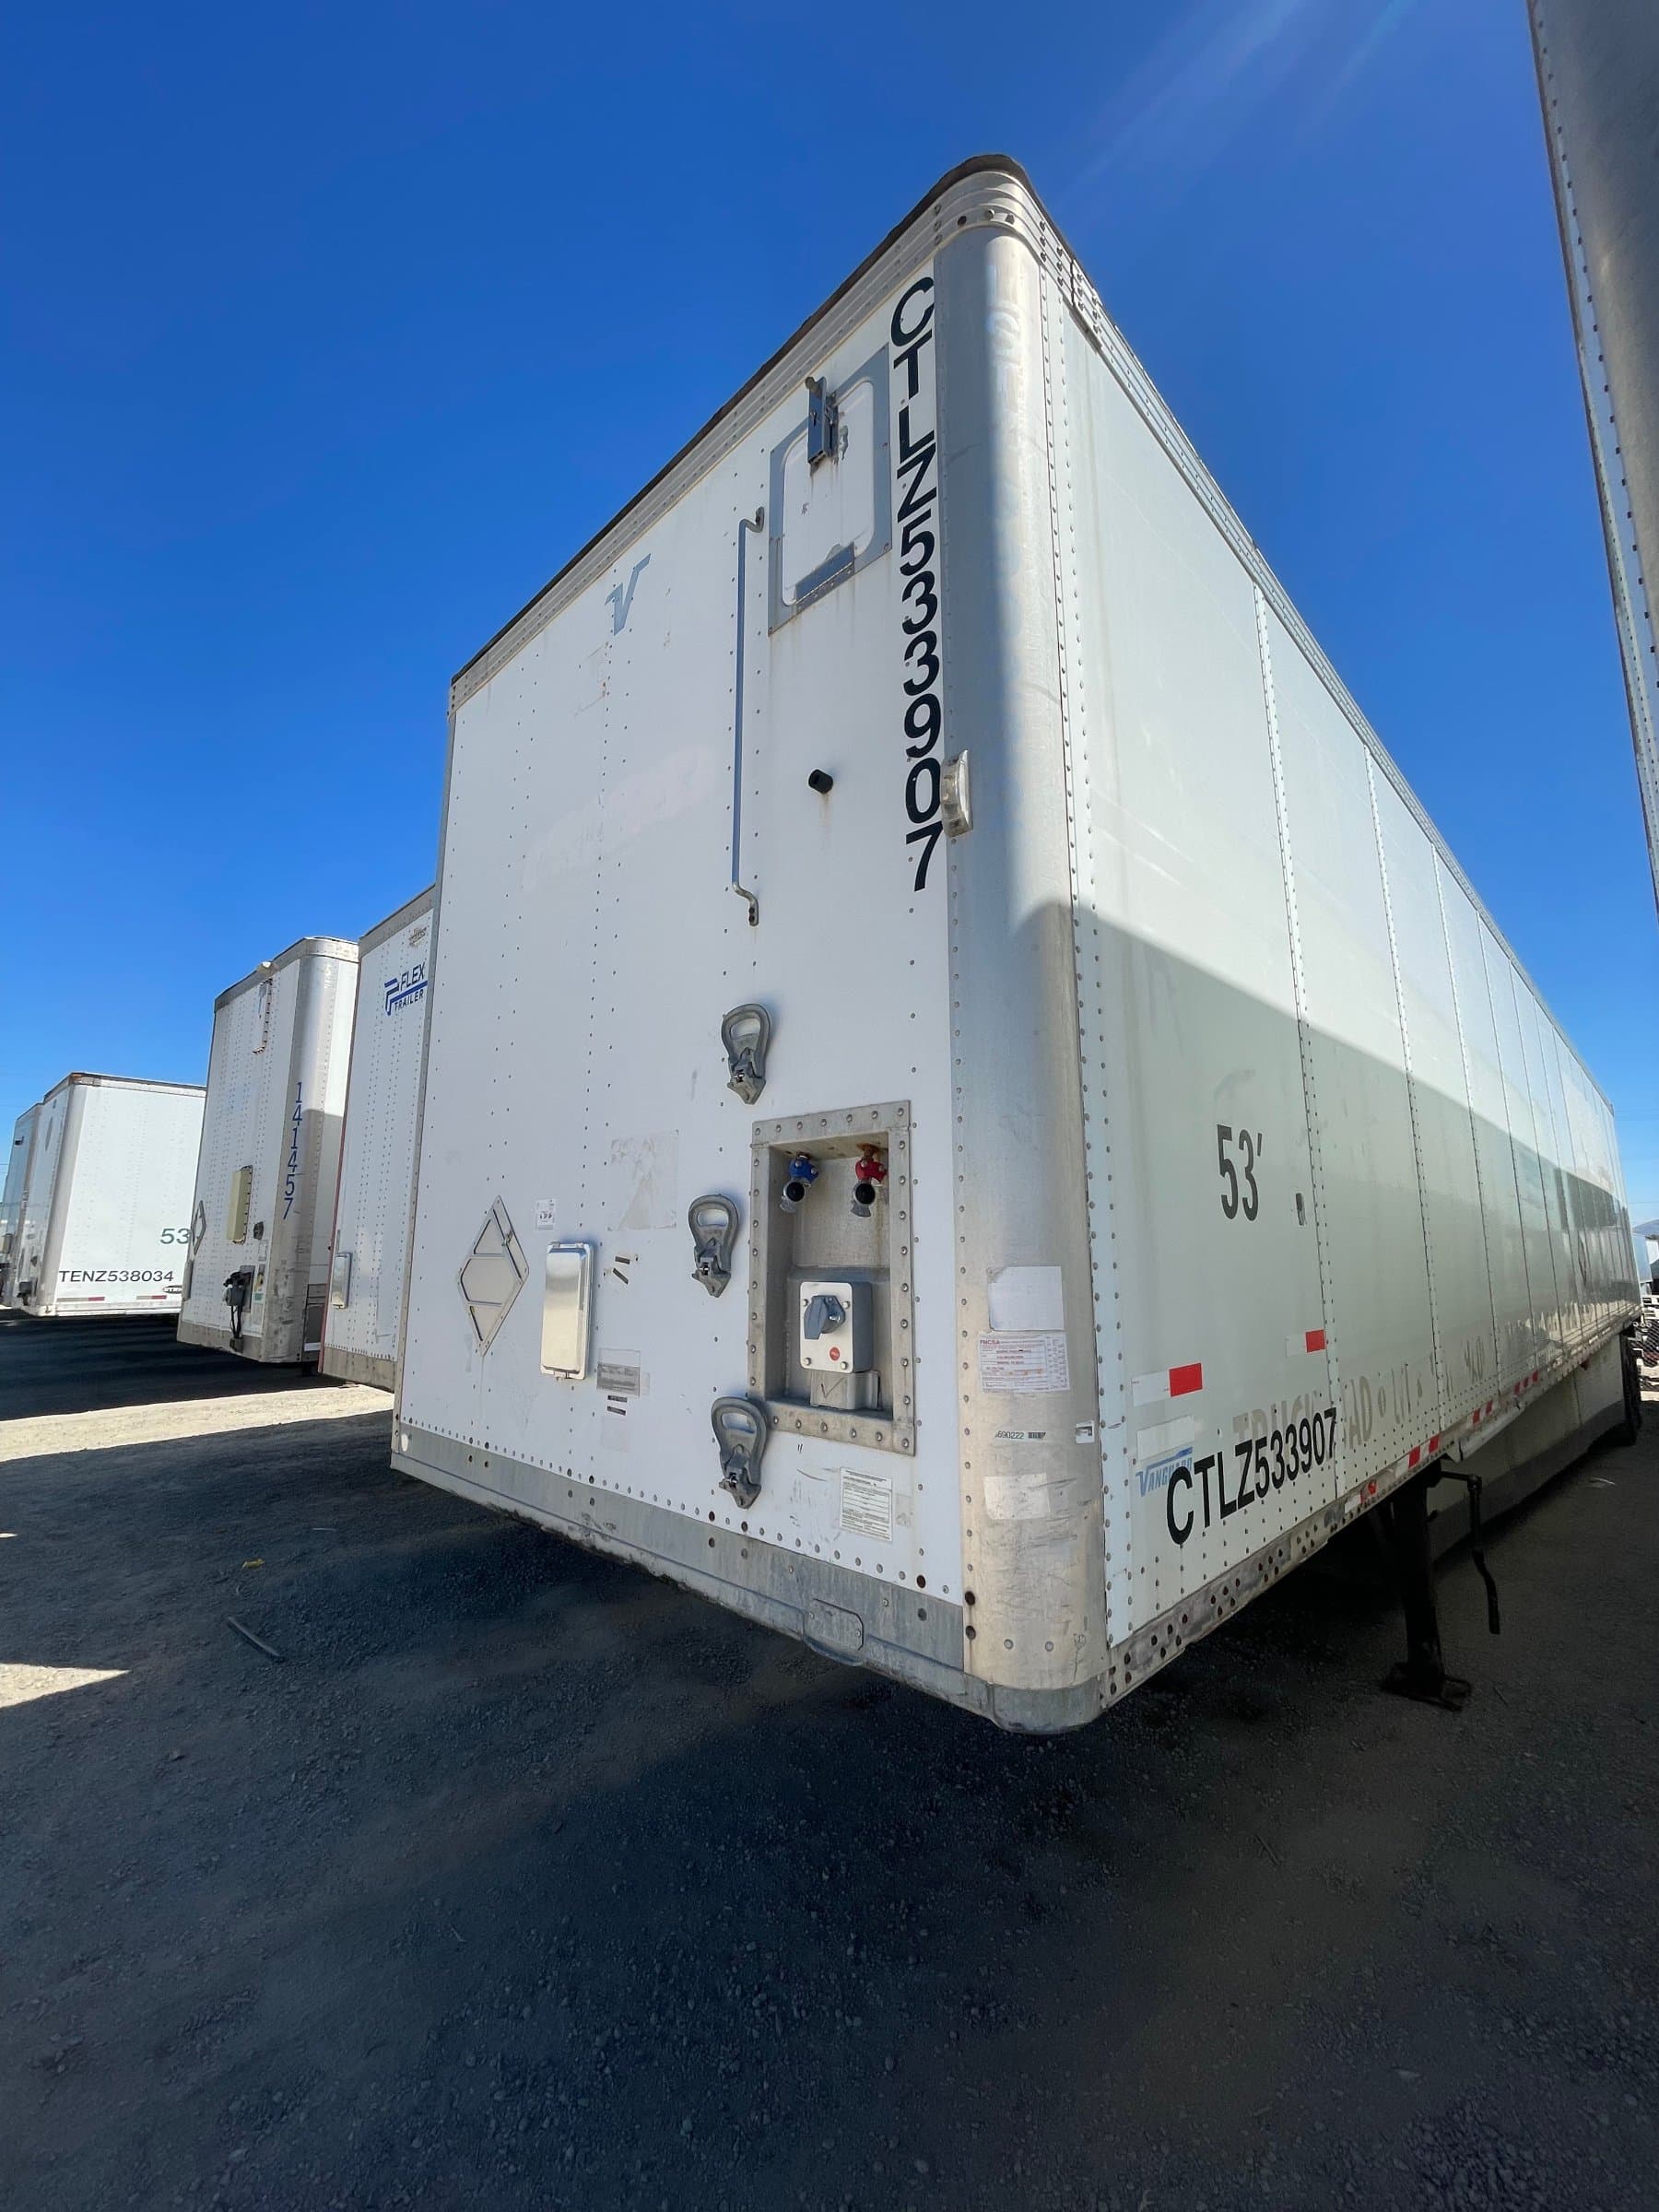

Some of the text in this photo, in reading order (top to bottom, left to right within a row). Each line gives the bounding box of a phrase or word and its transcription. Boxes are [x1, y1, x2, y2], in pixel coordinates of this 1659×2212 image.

[889, 277, 944, 891] CTLZ533907
[394, 989, 424, 1011] TRAILER
[400, 961, 426, 991] FLEX
[283, 1082, 303, 1219] 141457
[59, 1270, 174, 1282] TENZ538034
[1166, 1406, 1337, 1546] CTLZ533907
